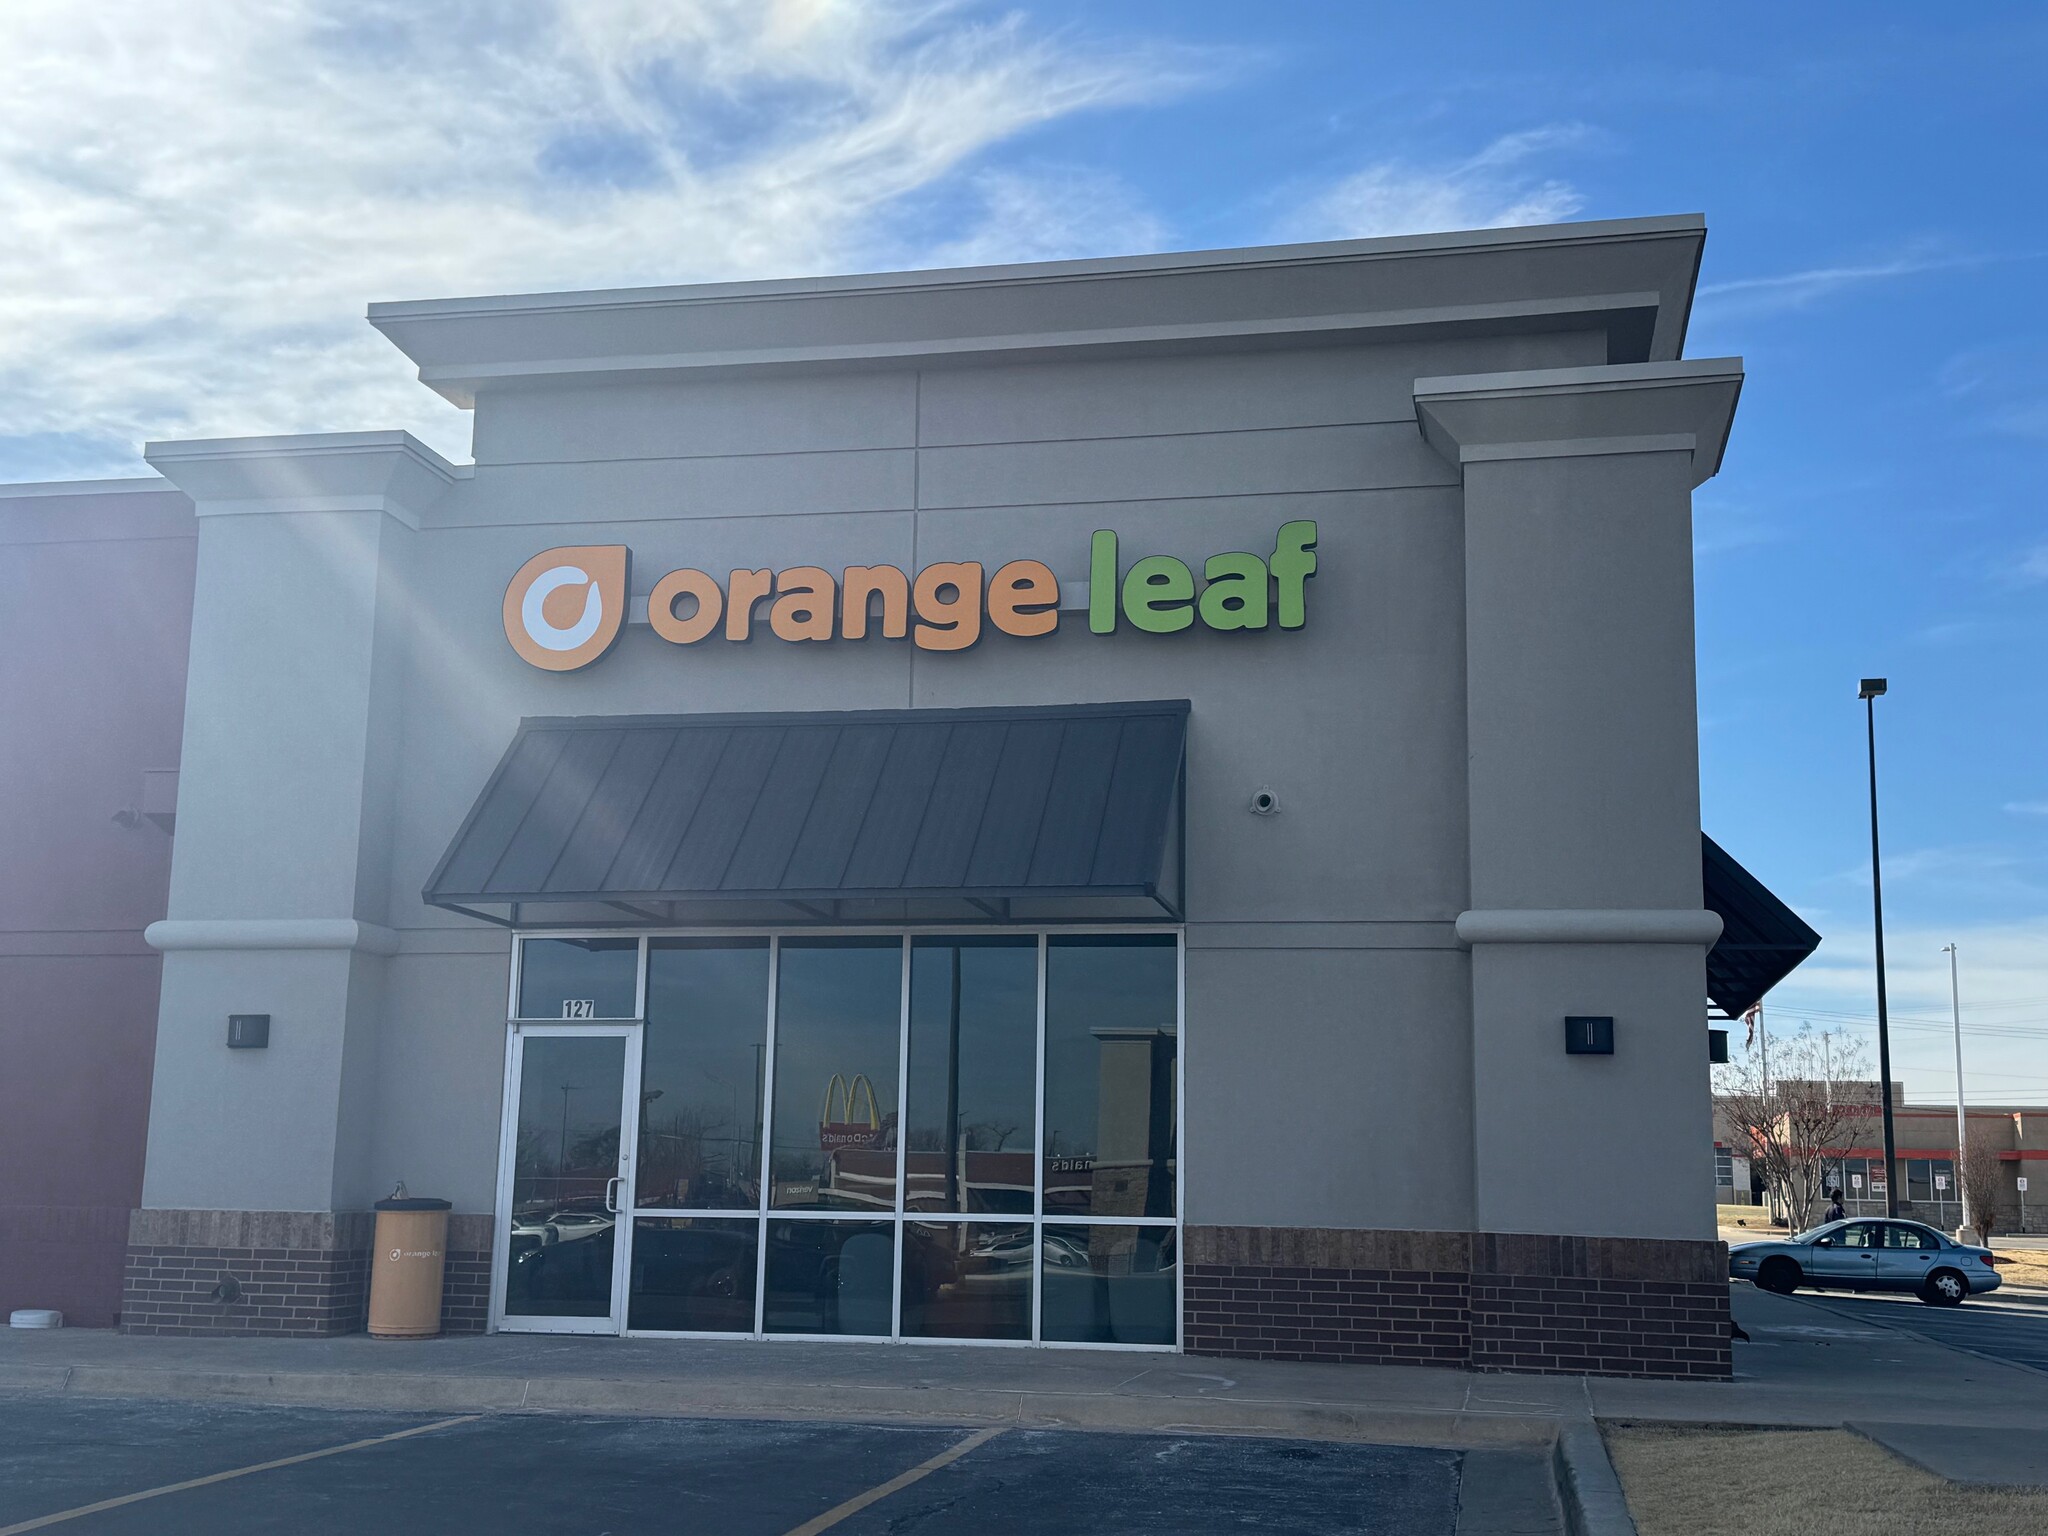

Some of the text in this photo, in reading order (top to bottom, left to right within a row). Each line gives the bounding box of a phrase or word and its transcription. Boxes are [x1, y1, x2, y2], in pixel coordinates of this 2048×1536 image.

[647, 520, 1317, 651] orange leaf
[565, 1000, 593, 1018] 127
